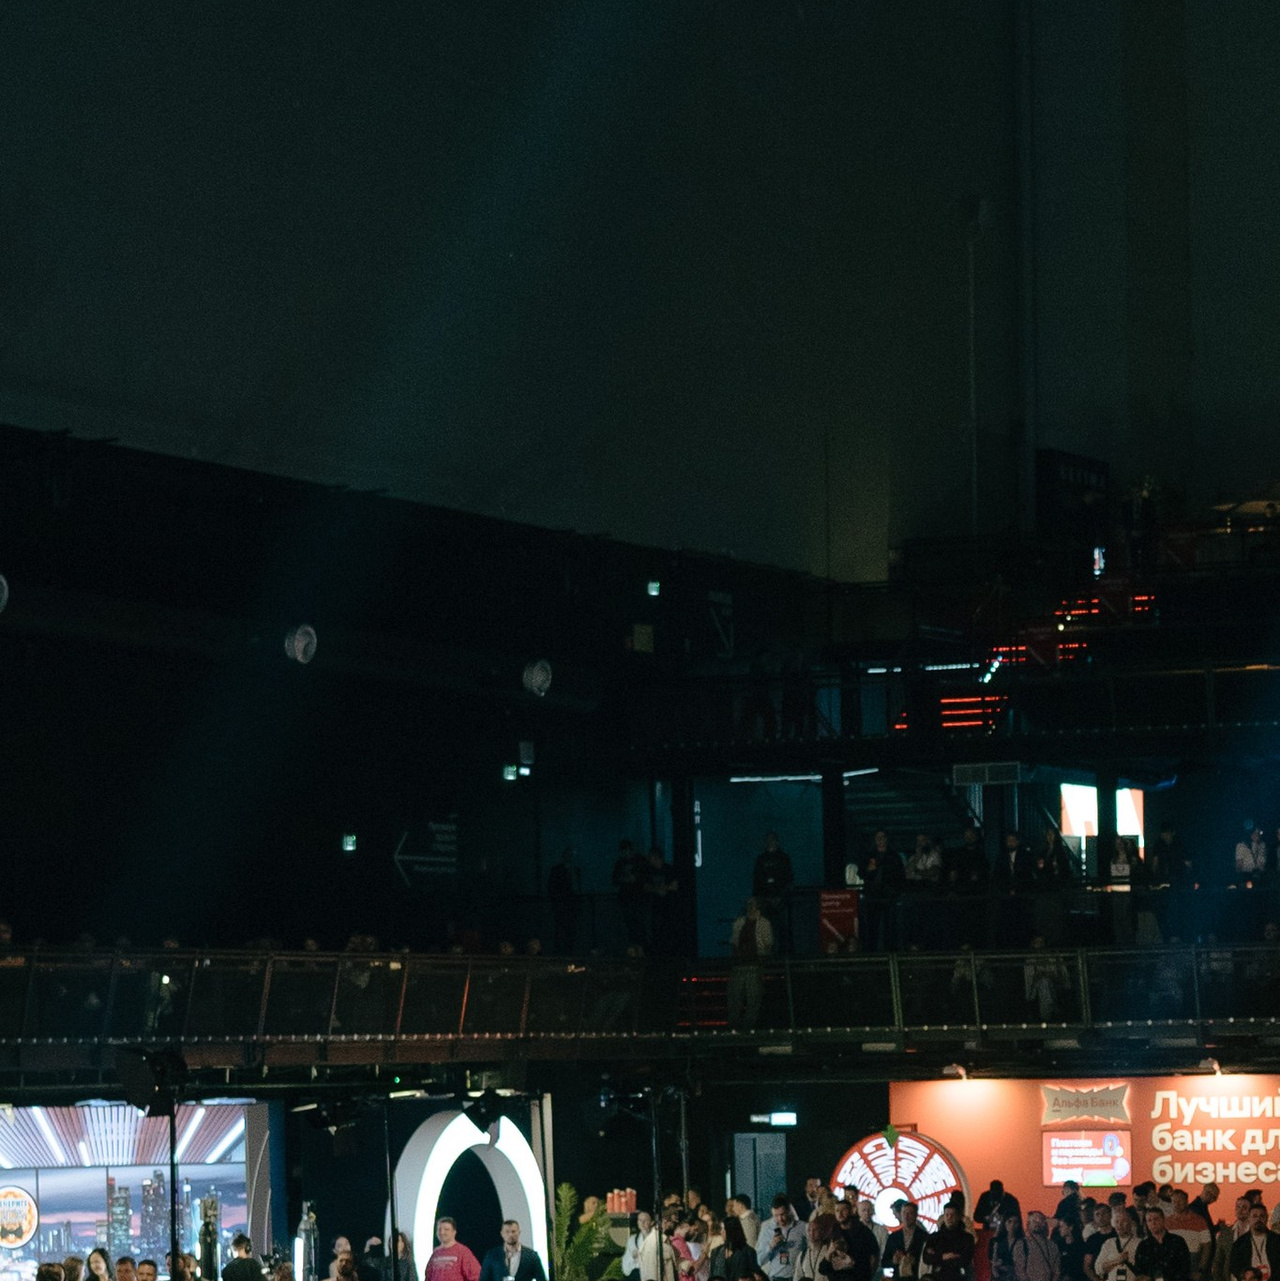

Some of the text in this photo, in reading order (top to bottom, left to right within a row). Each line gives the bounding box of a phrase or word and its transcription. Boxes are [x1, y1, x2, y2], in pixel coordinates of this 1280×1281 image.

[1052, 1096, 1119, 1110] Альфа Банк
[1151, 1122, 1237, 1151] банк
